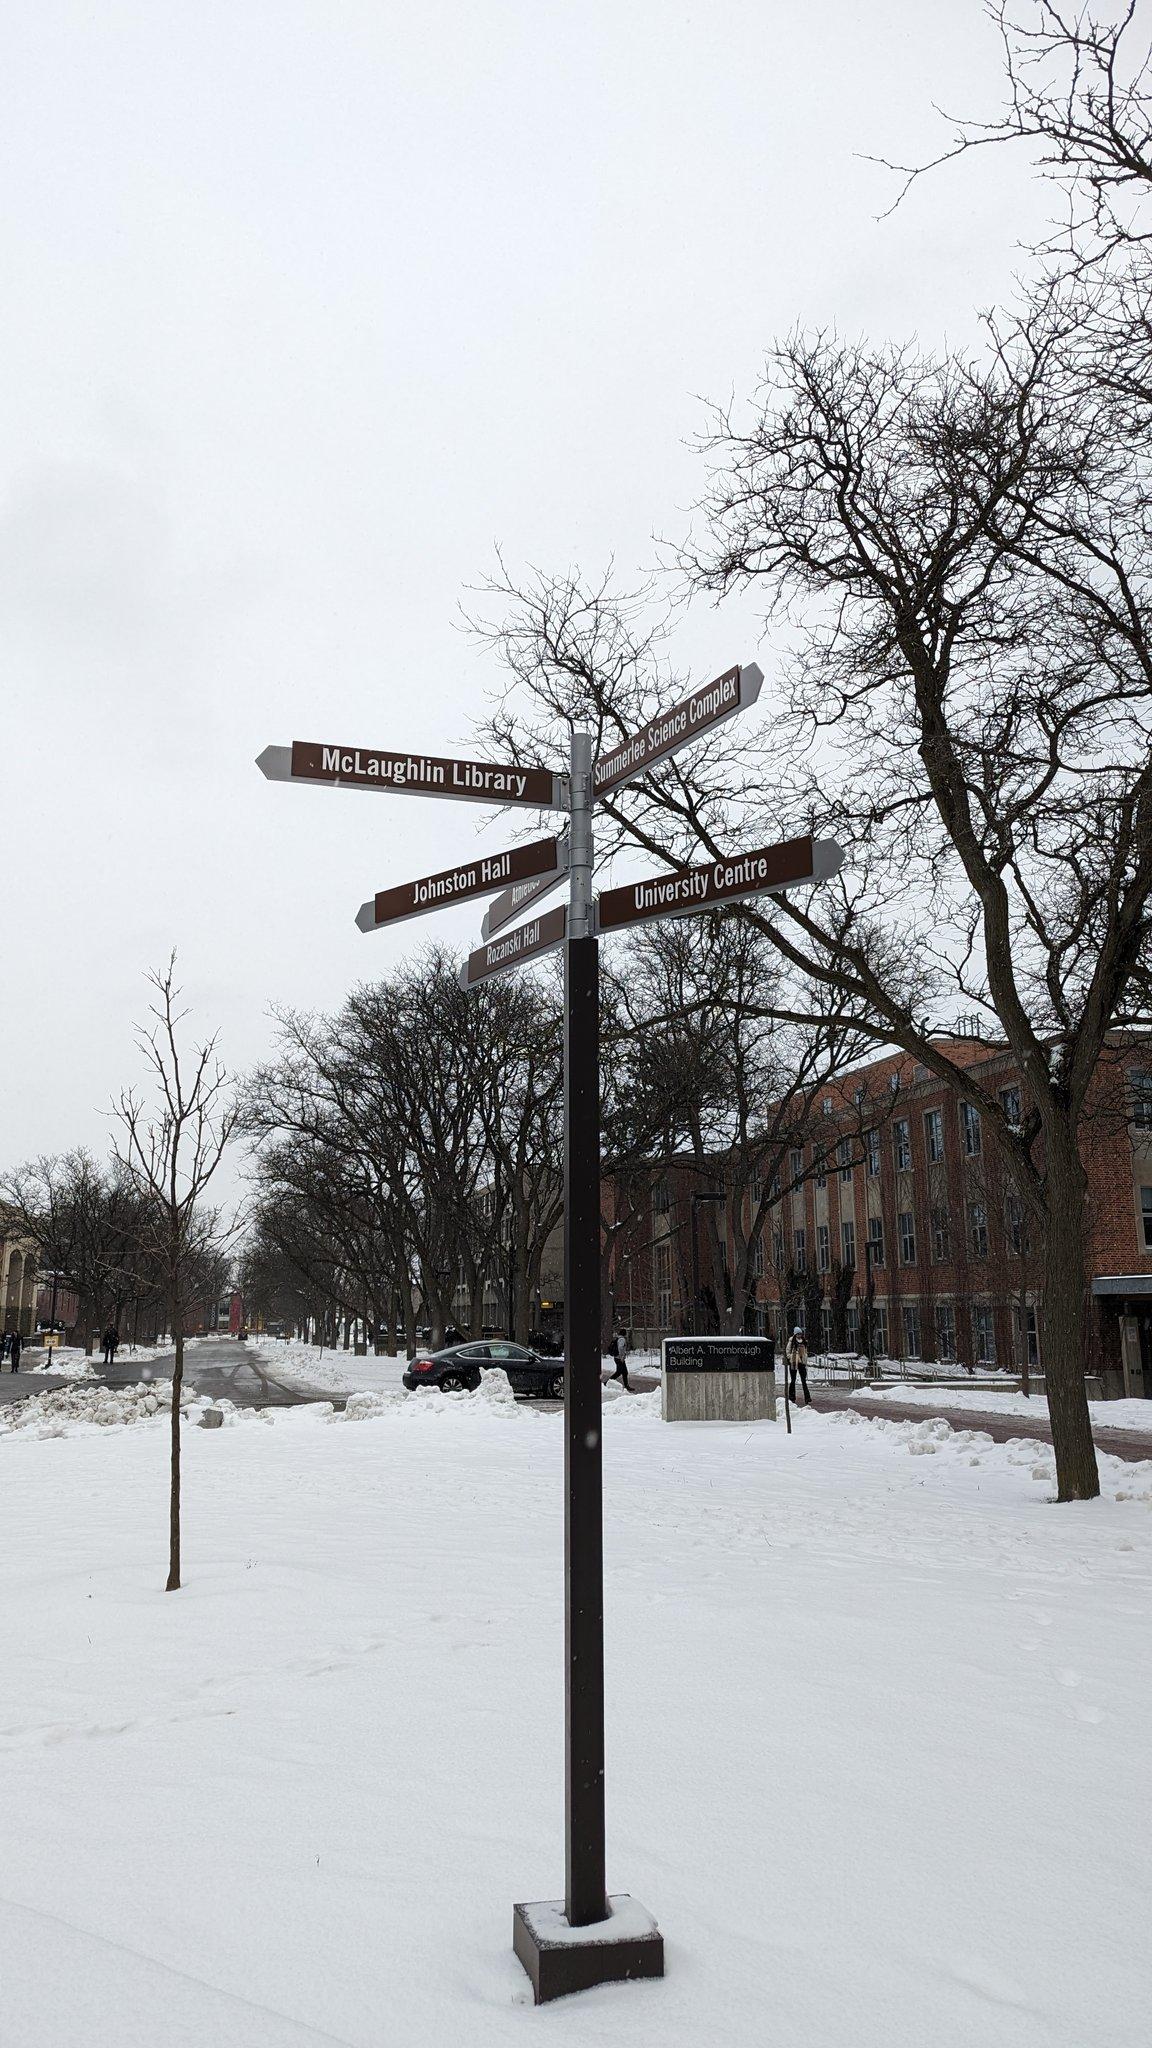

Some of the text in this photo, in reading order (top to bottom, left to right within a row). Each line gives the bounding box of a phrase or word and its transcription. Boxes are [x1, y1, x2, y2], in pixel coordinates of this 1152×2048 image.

[594, 676, 736, 786] Summerlee Science Complex
[322, 747, 527, 797] McLaughlin Library
[413, 854, 511, 904] Johnston Hall
[634, 858, 767, 910] University Centre
[486, 920, 540, 966] Rozanski Hall
[669, 1345, 761, 1356] Albert A. Thornbrough
[669, 1356, 703, 1367] Building
